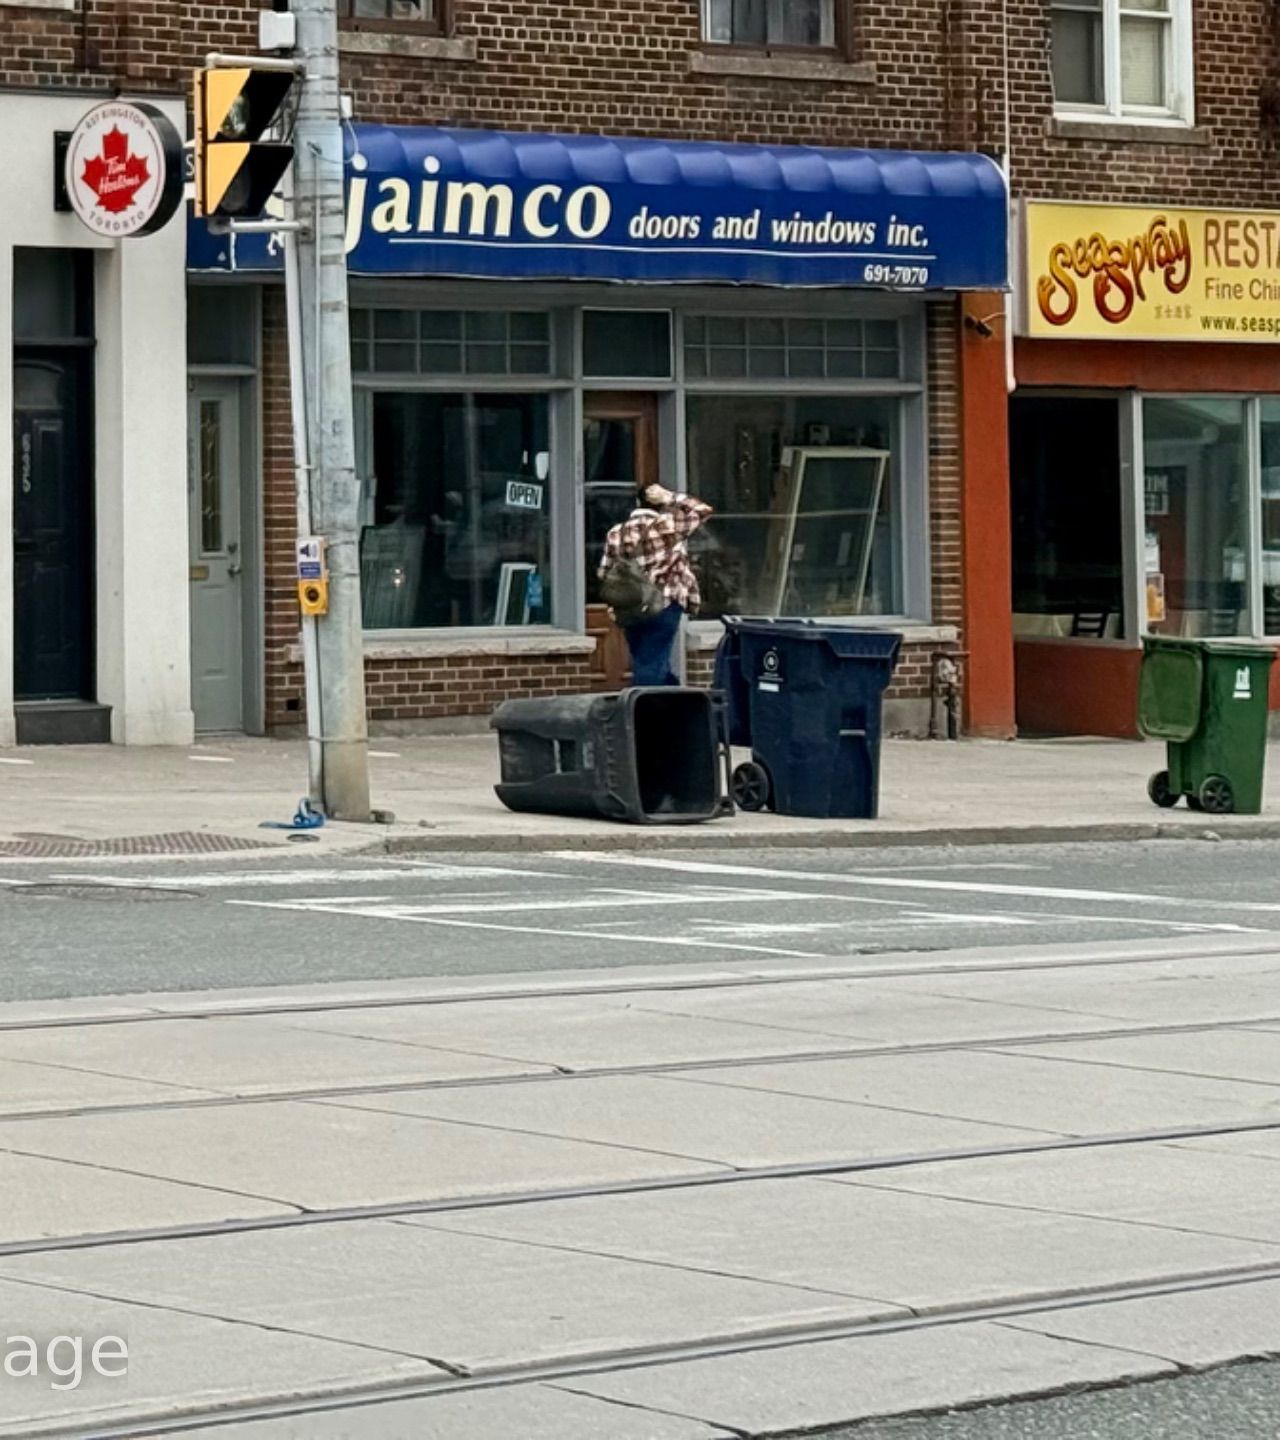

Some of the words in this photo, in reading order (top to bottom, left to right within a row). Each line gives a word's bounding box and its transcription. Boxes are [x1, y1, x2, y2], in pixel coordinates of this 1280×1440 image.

[89, 211, 145, 230] TORONTO
[629, 206, 701, 241] doors
[712, 208, 761, 242] and
[771, 210, 877, 246] windows
[887, 215, 929, 248] inc.
[1204, 219, 1280, 269] REST
[1205, 277, 1243, 300] Fine
[510, 484, 540, 506] OPEN
